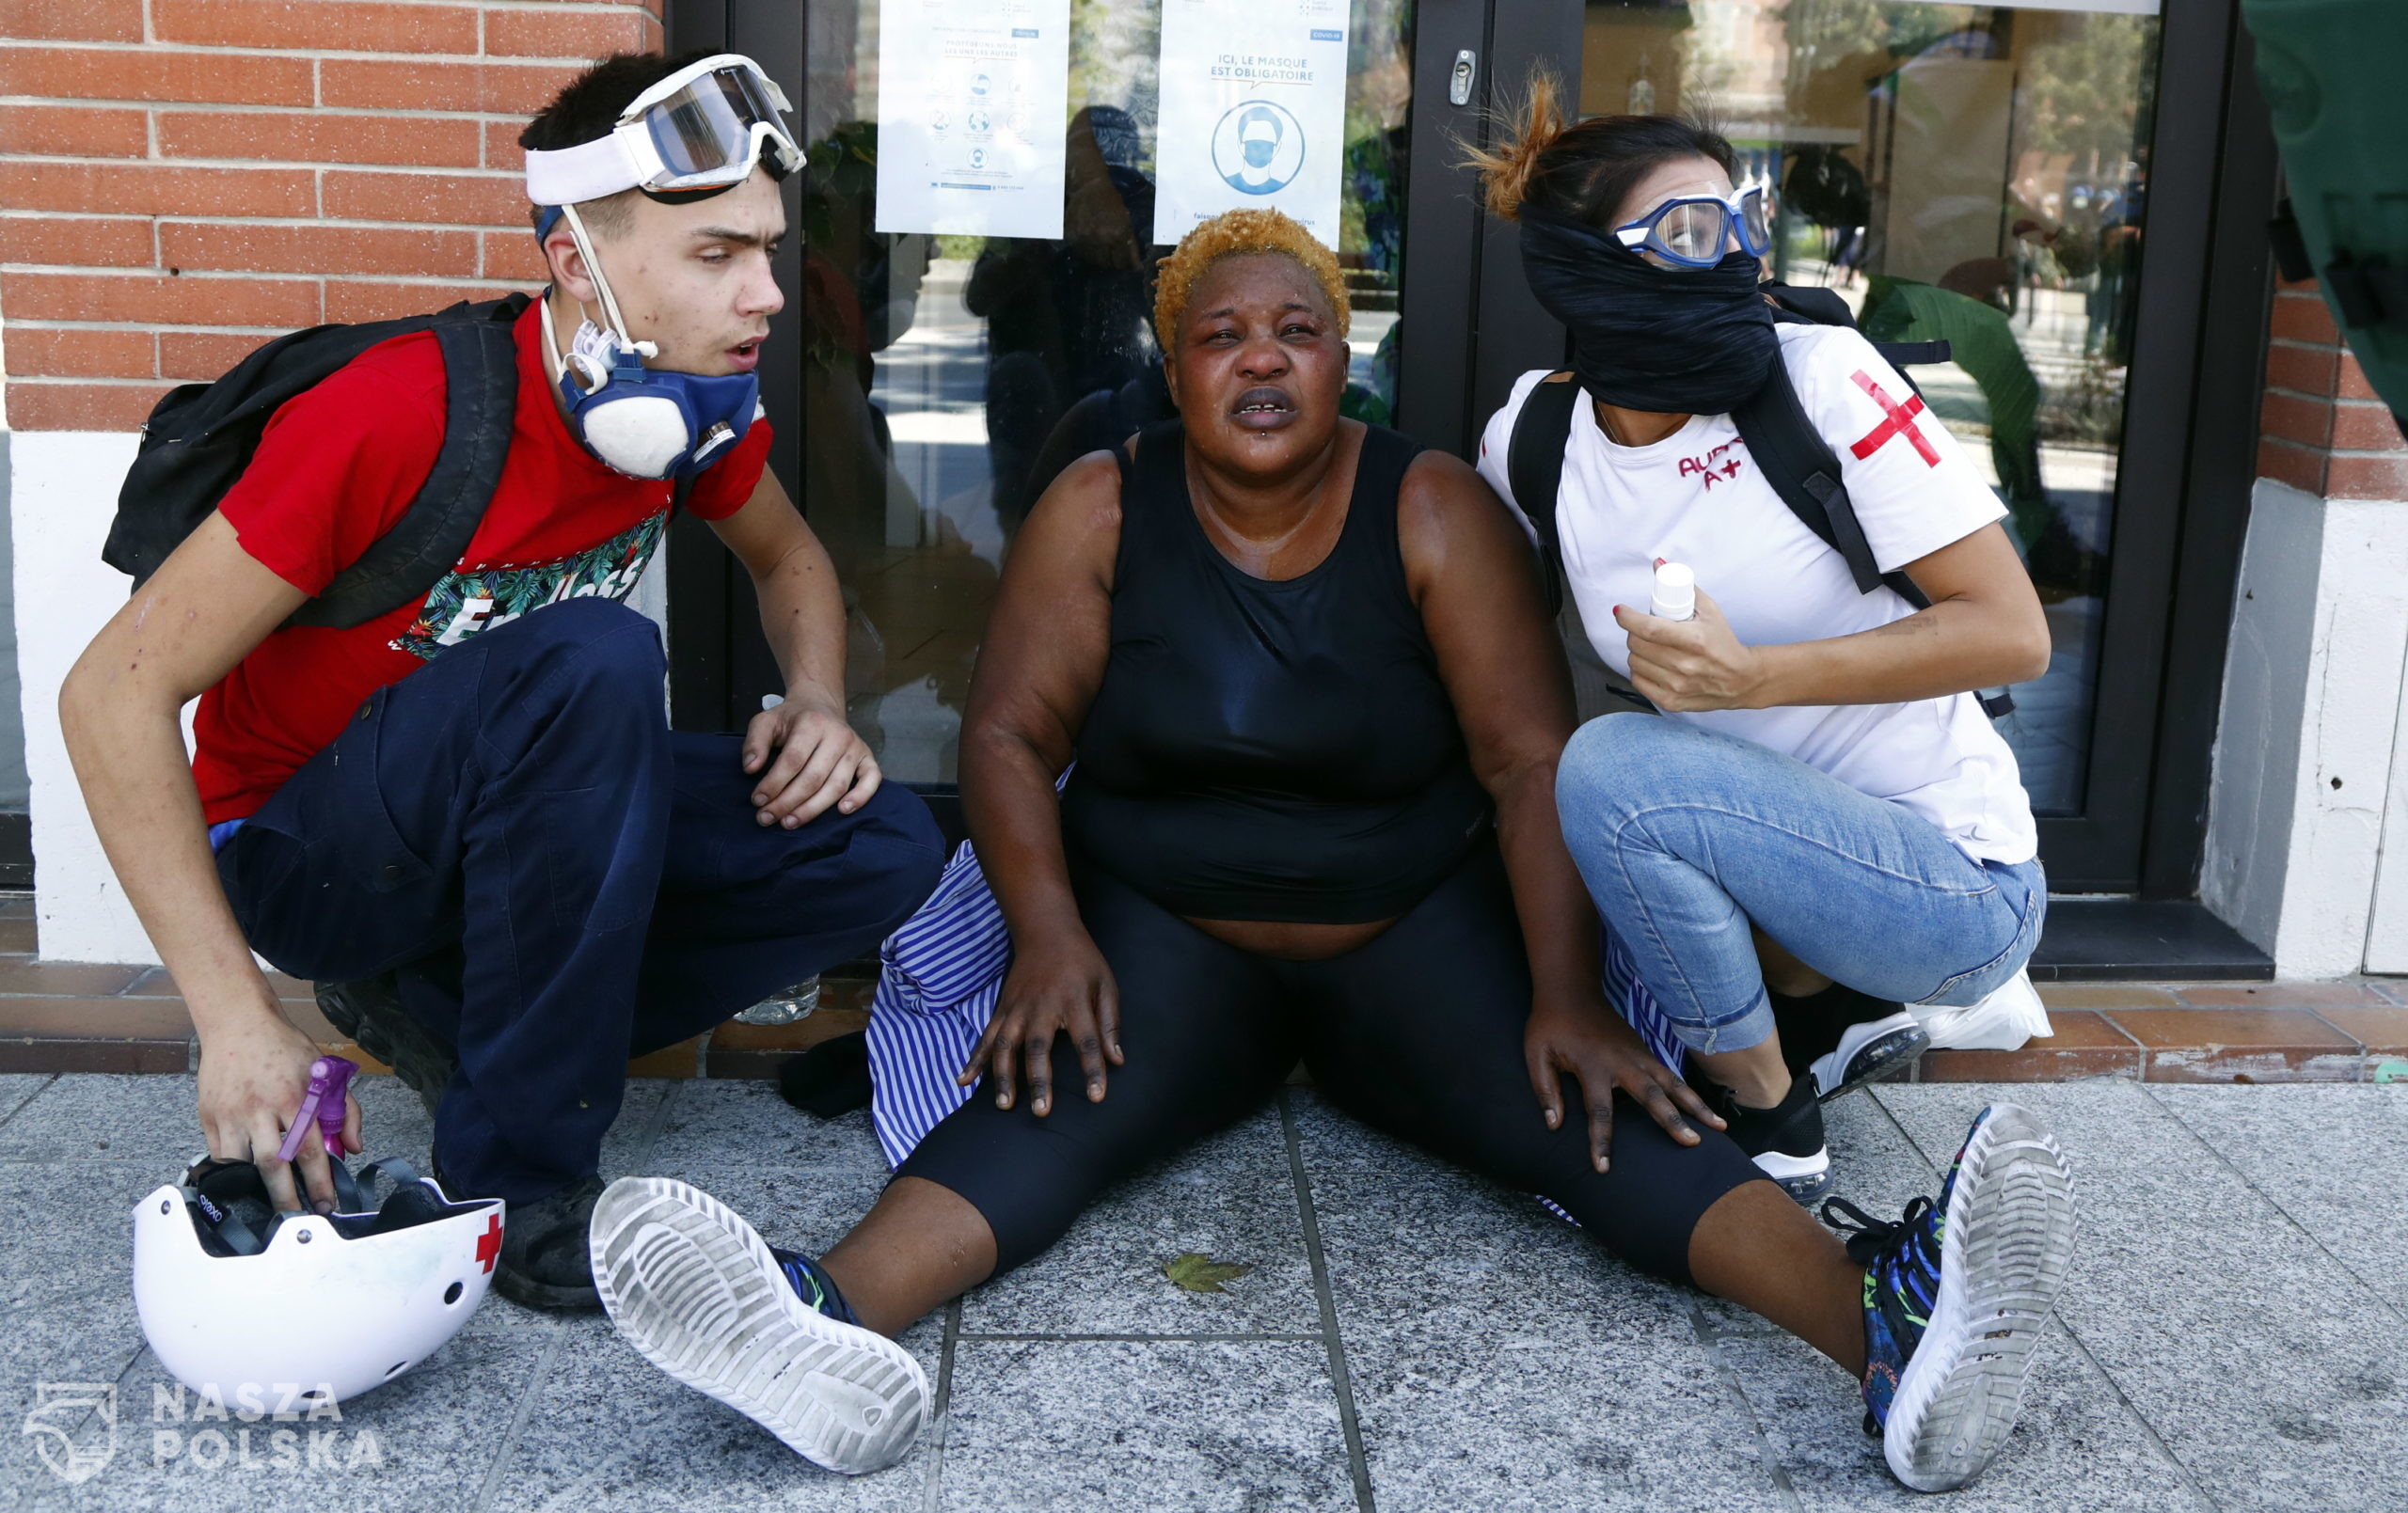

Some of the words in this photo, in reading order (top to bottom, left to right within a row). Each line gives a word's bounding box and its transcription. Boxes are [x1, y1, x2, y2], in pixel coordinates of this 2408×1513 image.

[1218, 55, 1238, 67] ICI,
[1242, 56, 1254, 66] LE
[1258, 56, 1307, 69] MASQUE
[1211, 66, 1231, 76] EST
[1234, 68, 1314, 81] OBLIGATOIRE
[199, 1193, 223, 1222] oxelo
